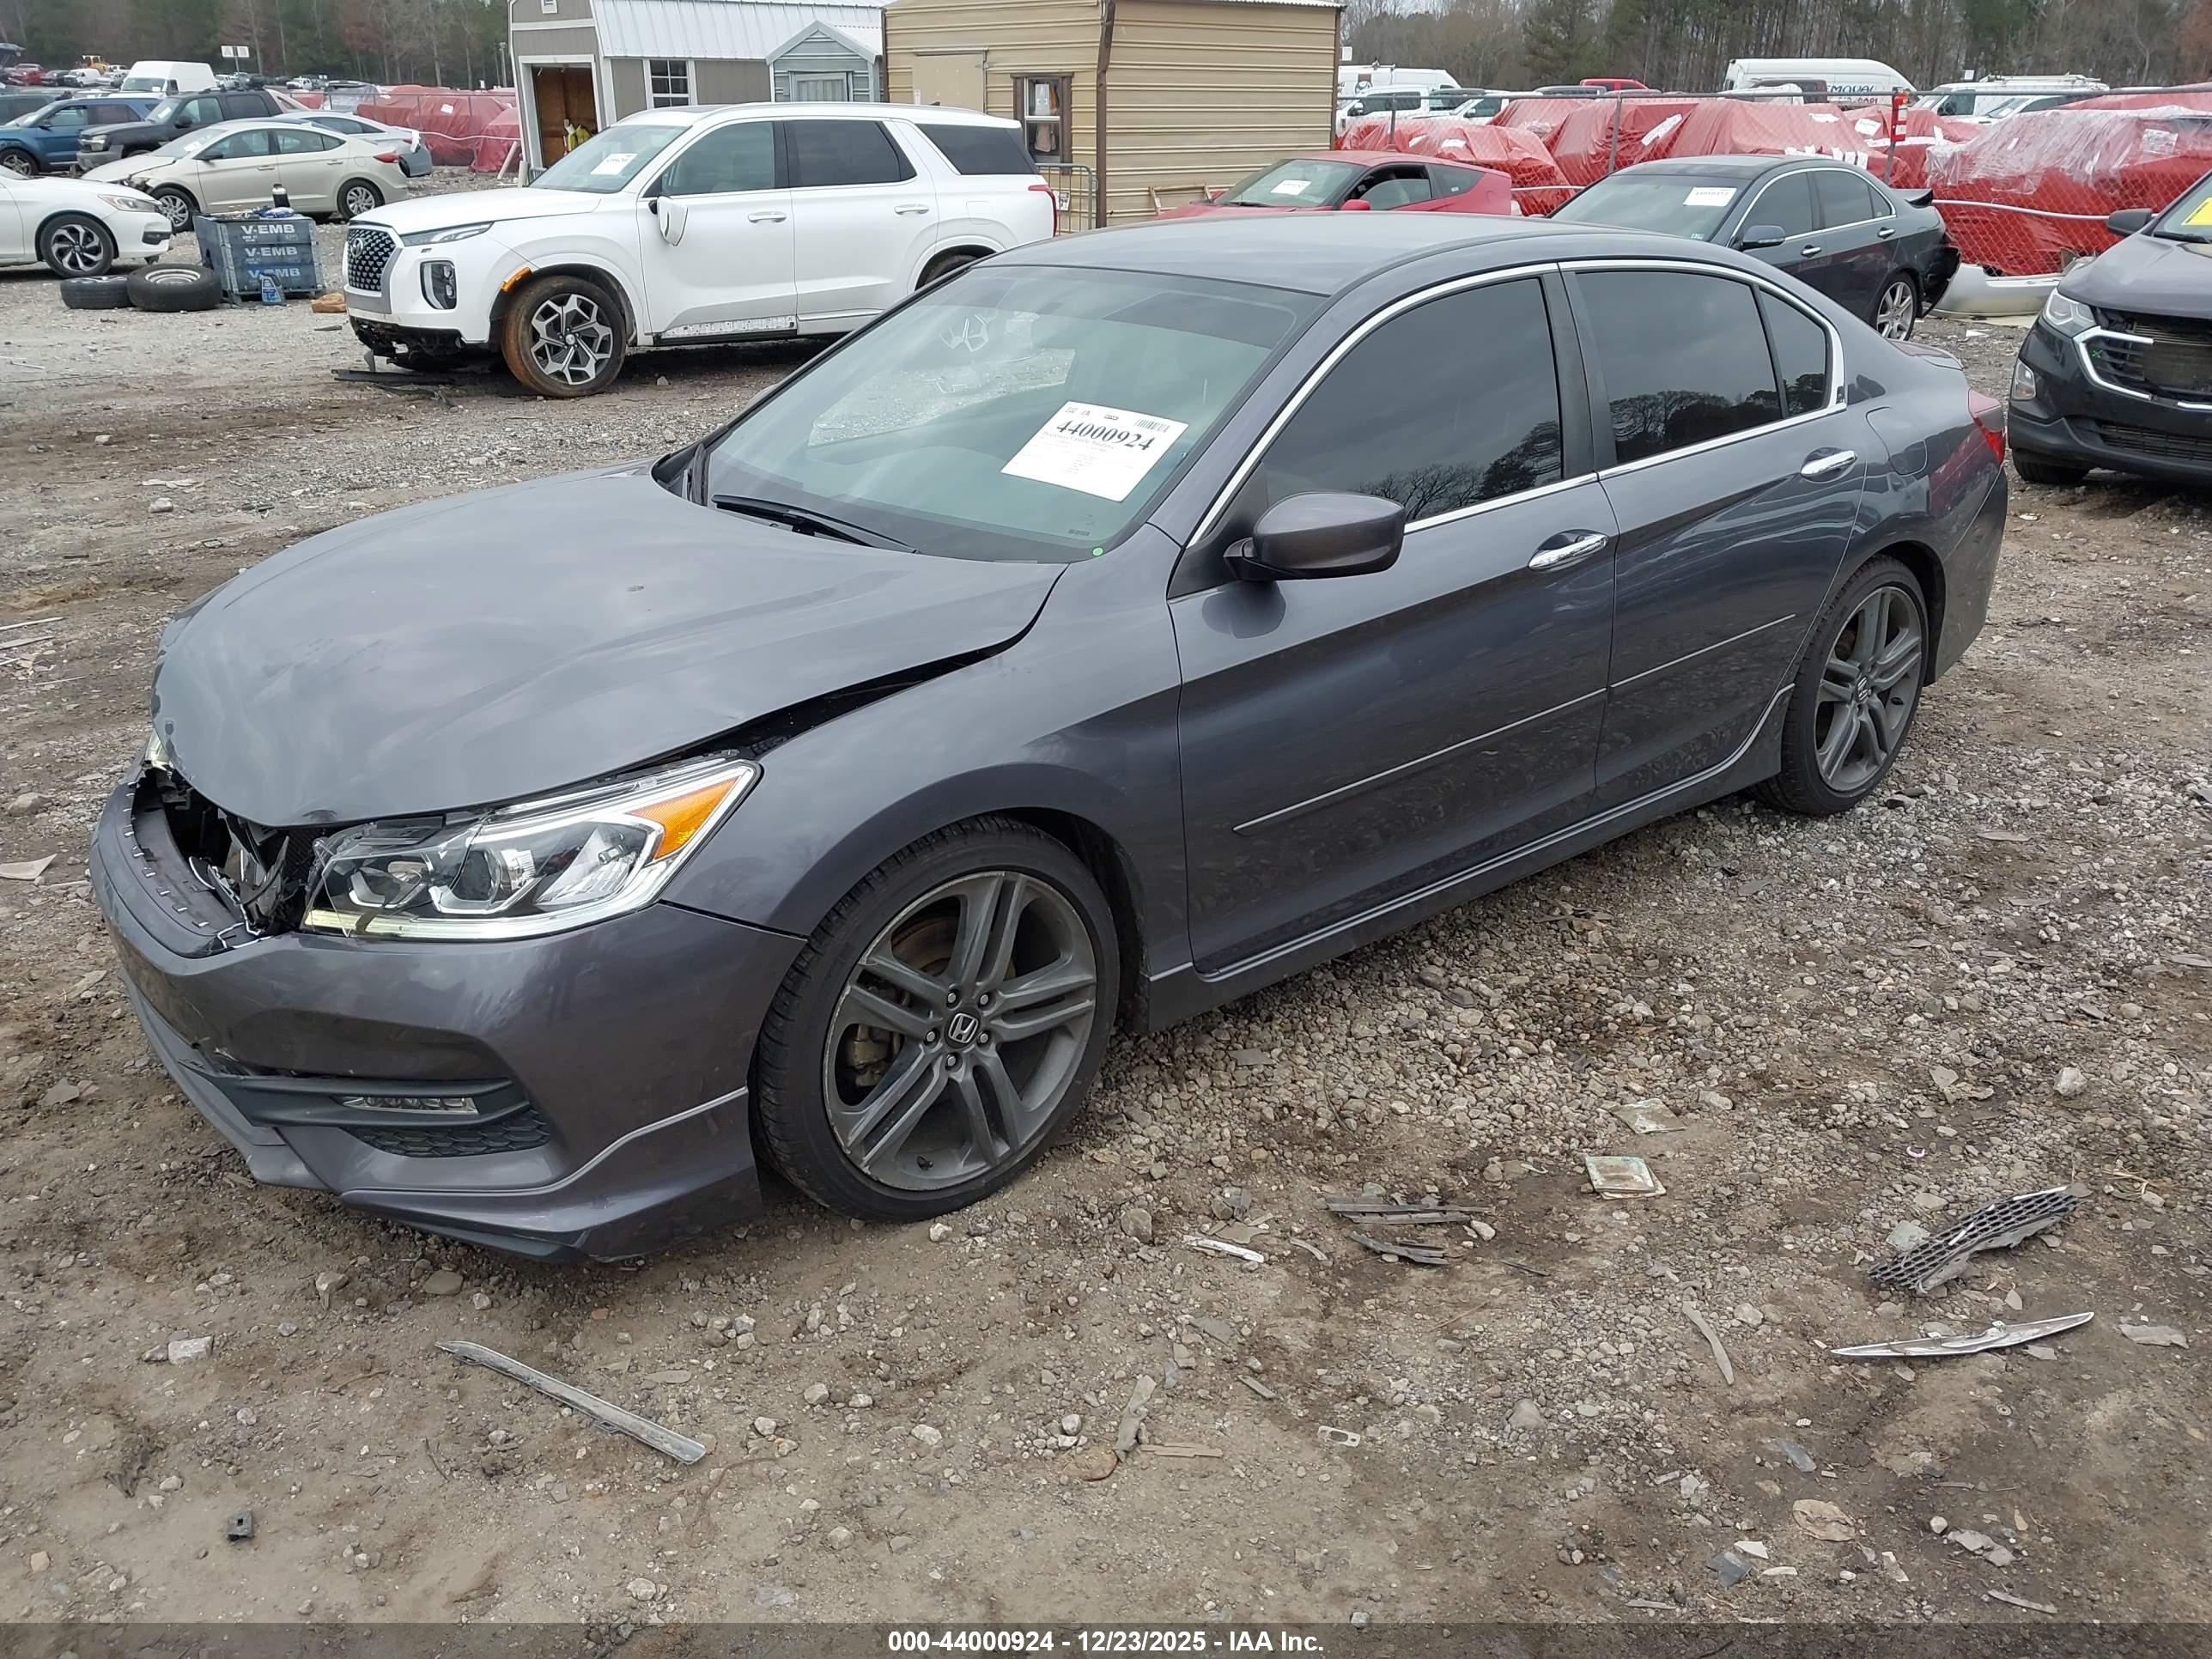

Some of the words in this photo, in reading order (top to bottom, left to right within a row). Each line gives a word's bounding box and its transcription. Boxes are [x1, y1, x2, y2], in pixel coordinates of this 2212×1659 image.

[1827, 84, 1875, 94] MOVAL
[240, 224, 295, 234] V-EMB
[245, 246, 298, 257] V-EMB
[1056, 420, 1156, 451] 44000924
